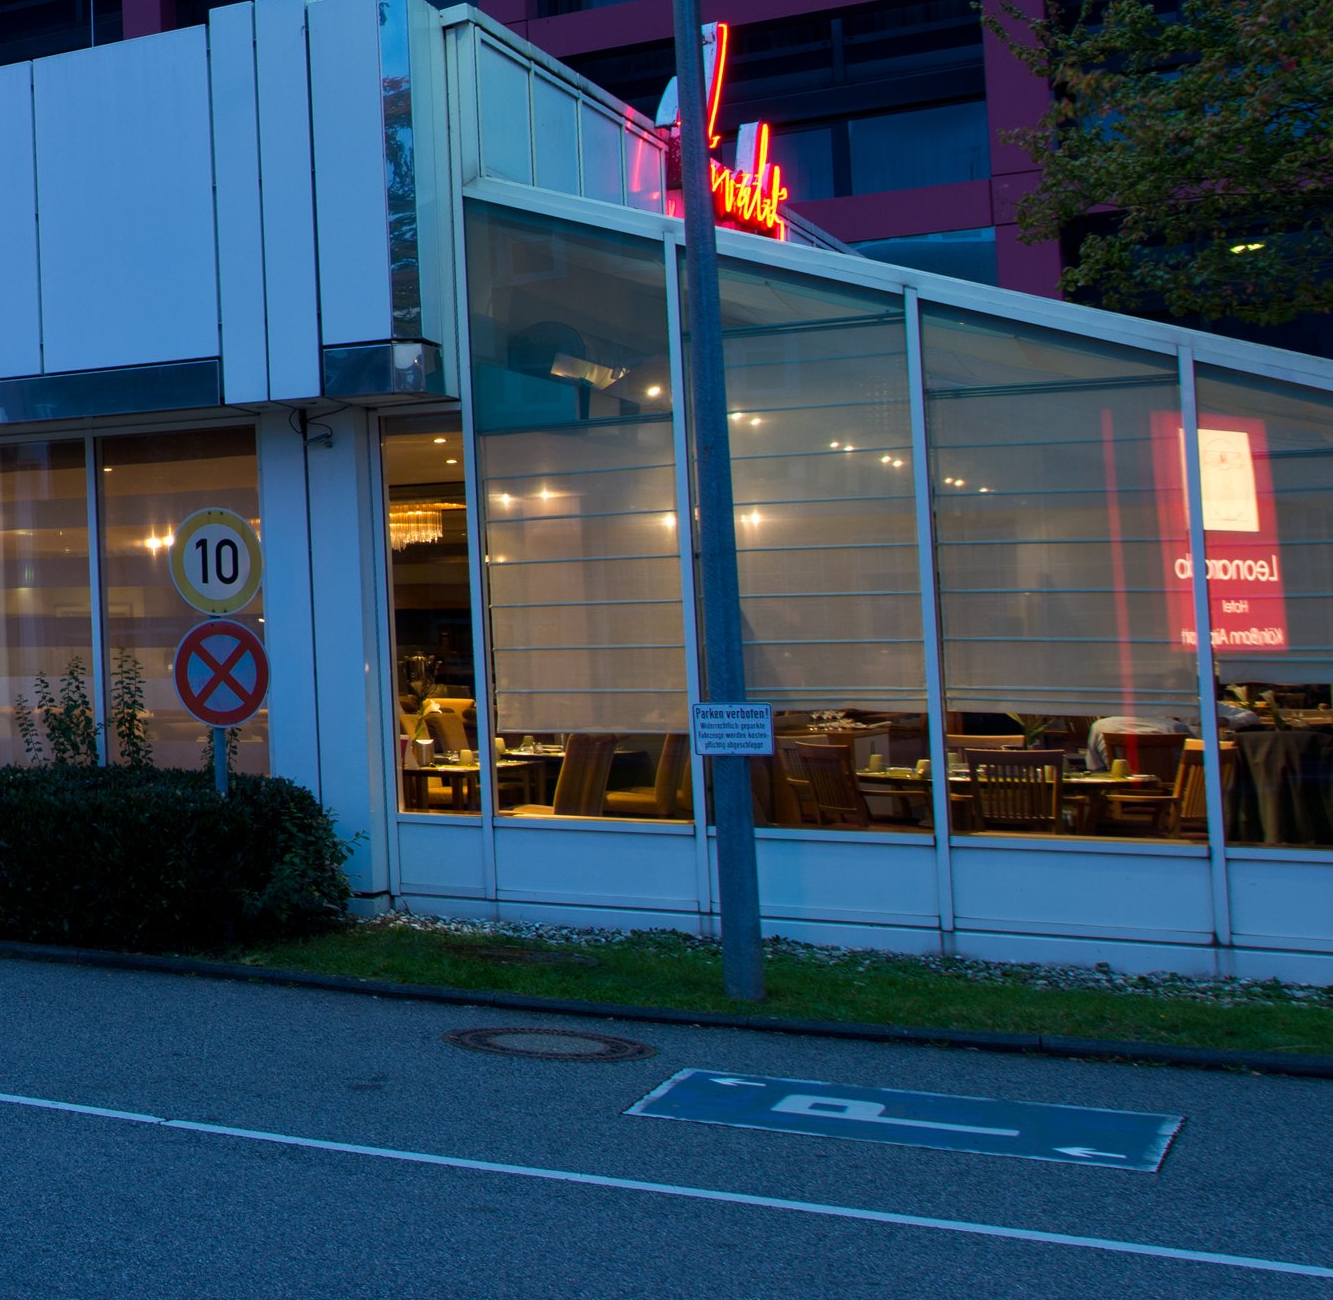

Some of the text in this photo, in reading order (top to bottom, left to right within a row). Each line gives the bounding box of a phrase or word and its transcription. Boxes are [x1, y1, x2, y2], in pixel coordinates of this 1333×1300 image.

[196, 538, 239, 585] 10
[695, 707, 769, 719] Parken verboten!
[740, 722, 765, 730] geparkte
[698, 731, 724, 740] Fahrzeuge
[725, 731, 746, 739] werden
[705, 741, 764, 750] pflichtig abgeschleppt
